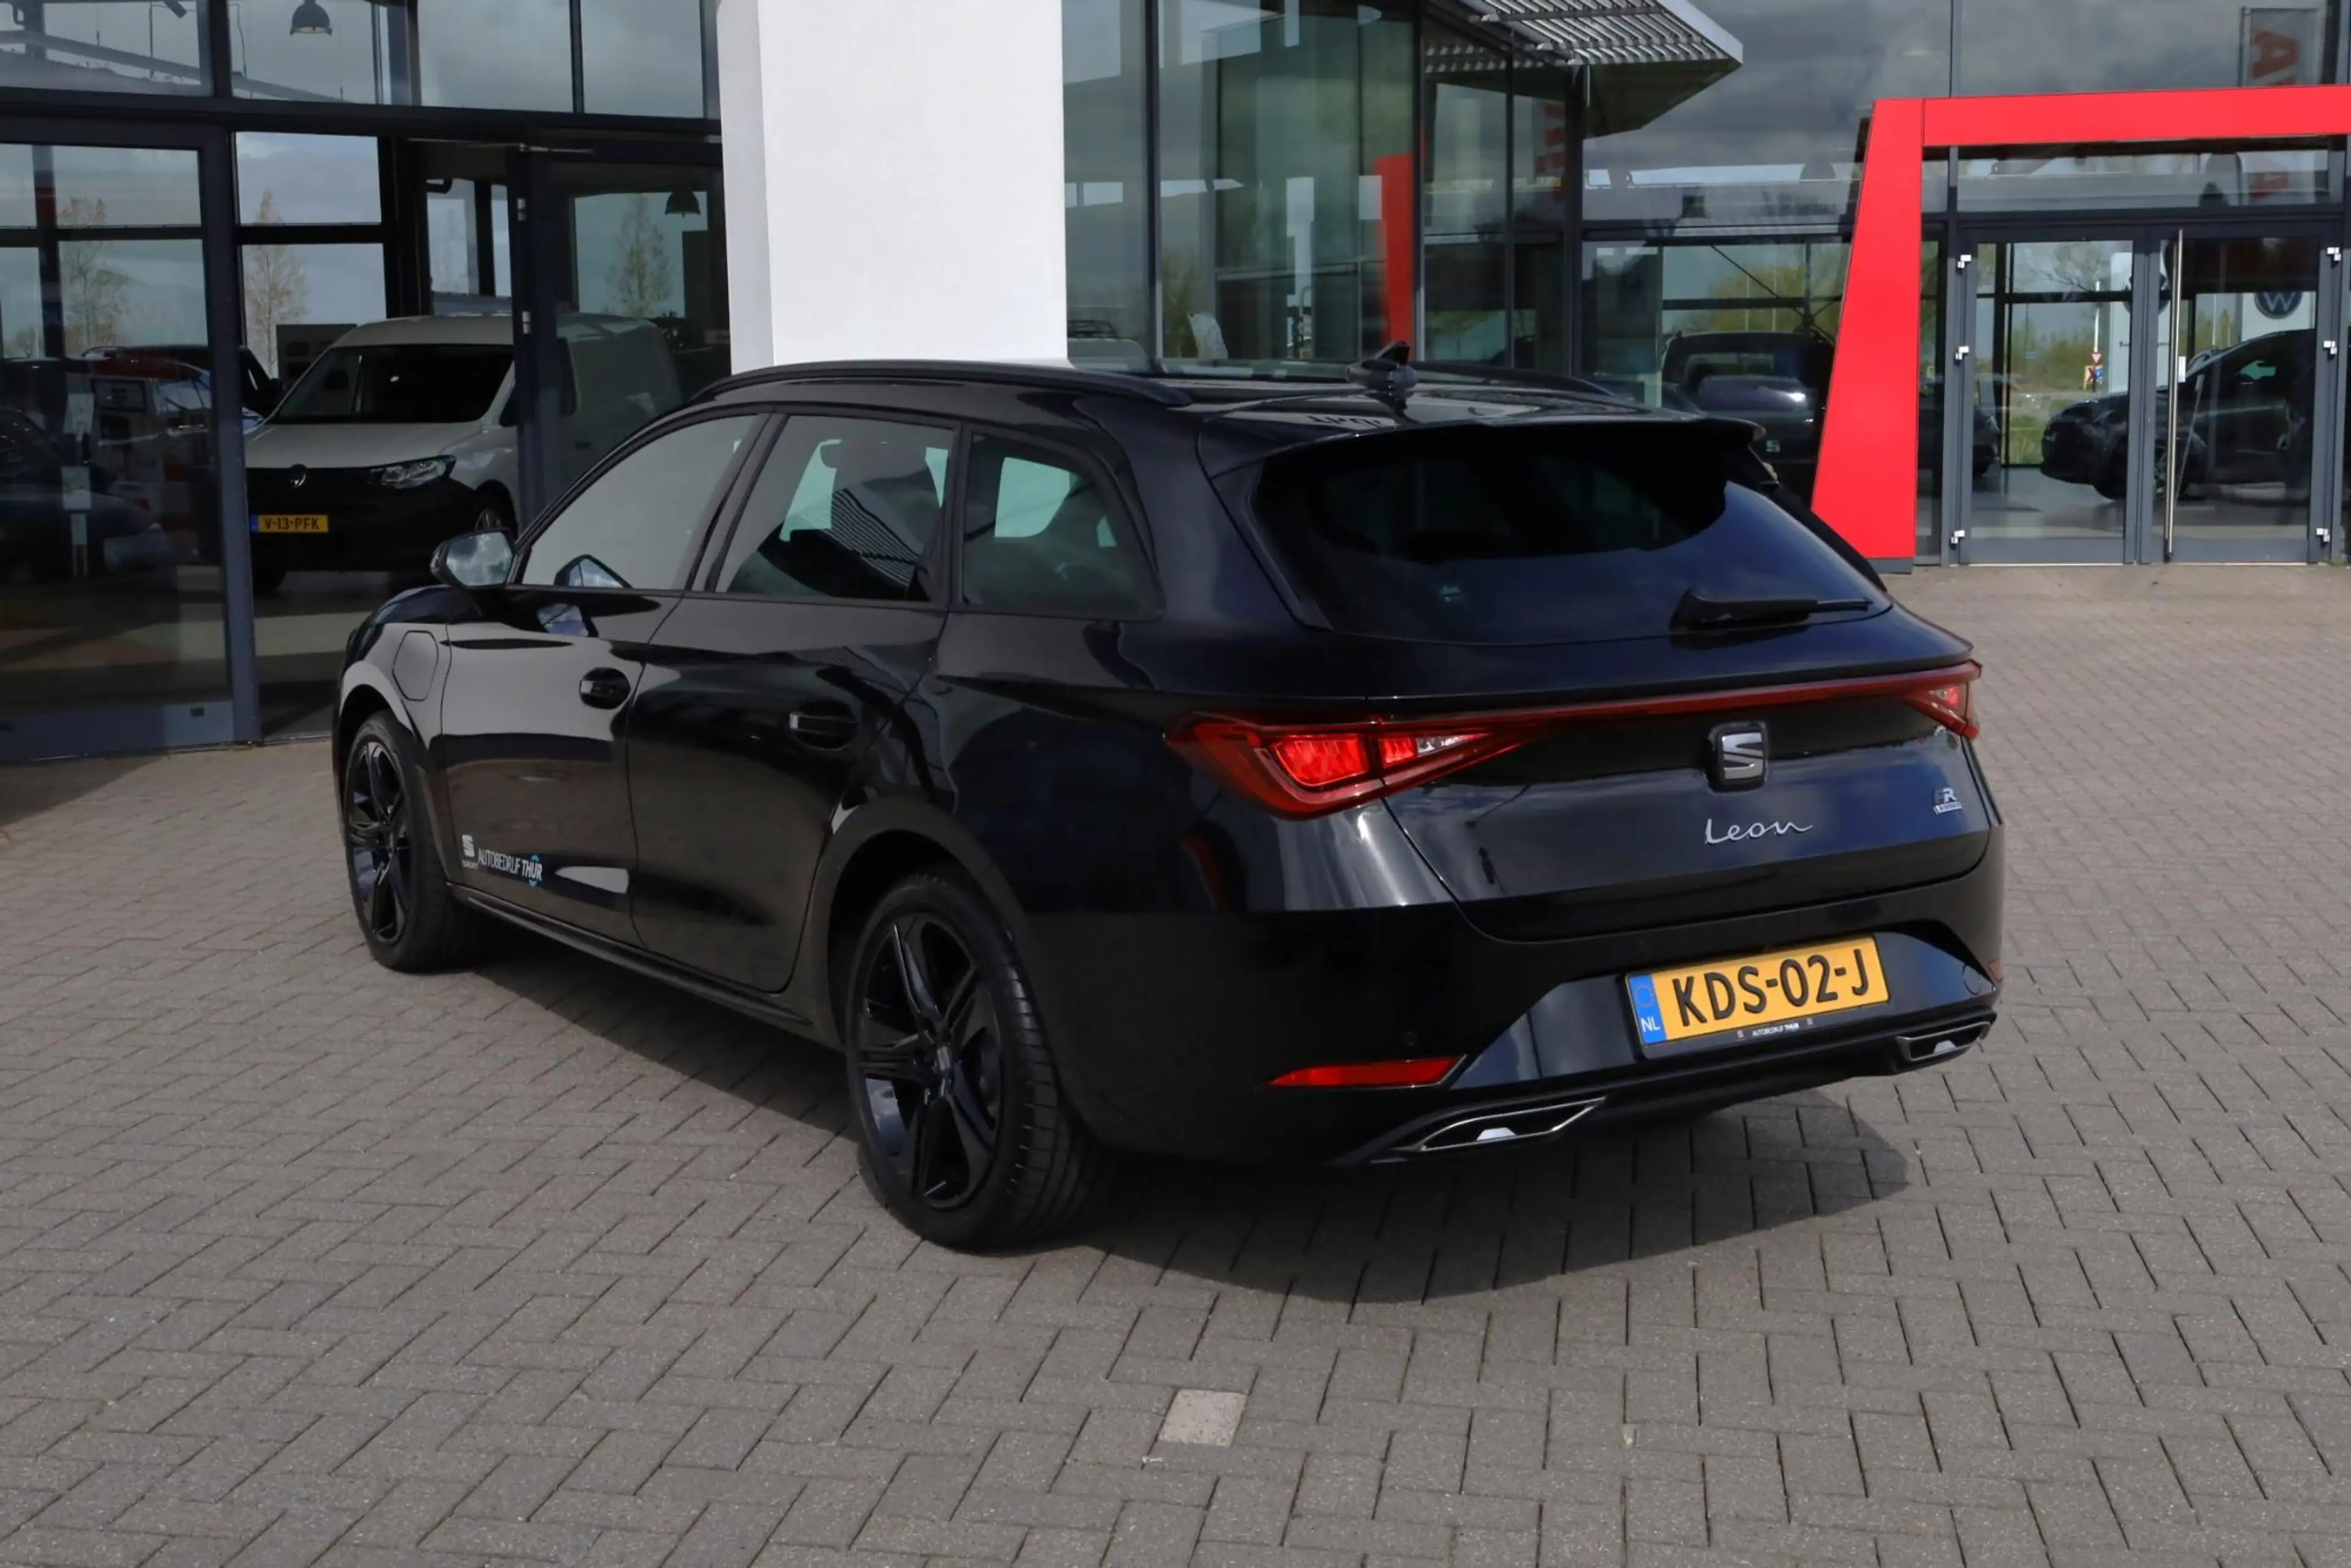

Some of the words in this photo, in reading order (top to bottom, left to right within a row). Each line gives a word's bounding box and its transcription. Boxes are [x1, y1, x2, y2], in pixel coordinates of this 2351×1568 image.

[264, 516, 320, 530] V-13-PFK
[1704, 818, 1813, 844] Leon
[522, 858, 542, 882] THUR
[1672, 949, 1869, 1027] KDS-02-J
[1640, 1016, 1661, 1033] NL
